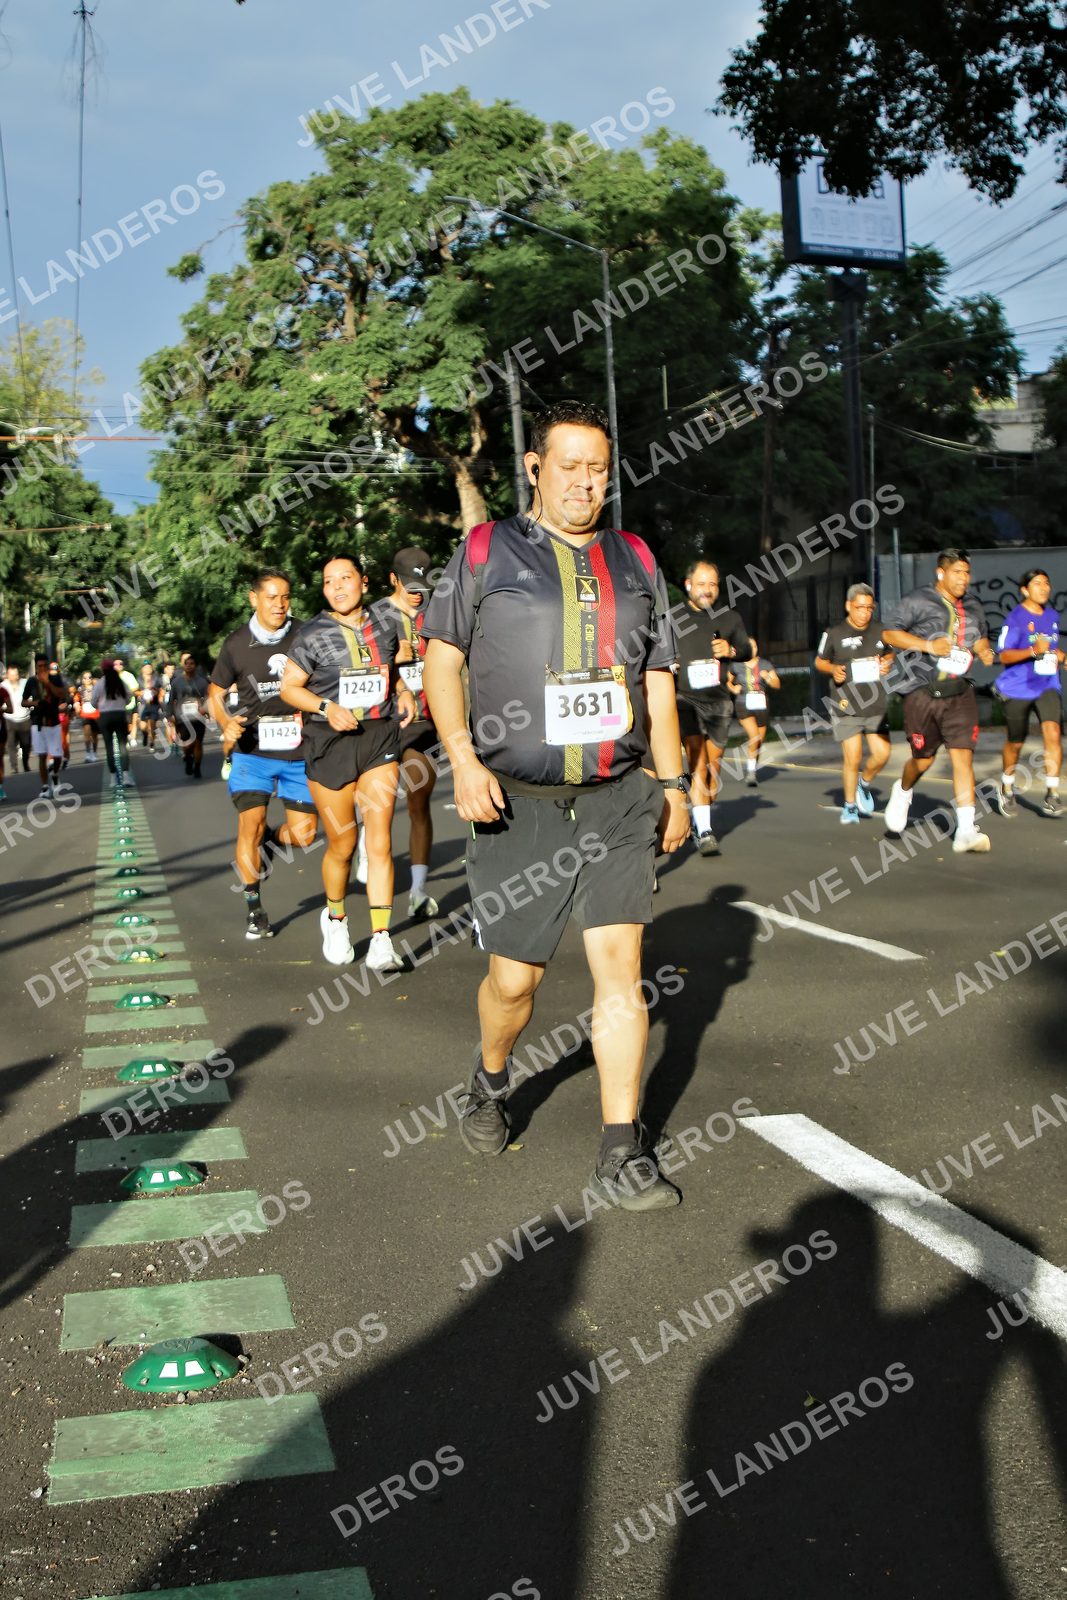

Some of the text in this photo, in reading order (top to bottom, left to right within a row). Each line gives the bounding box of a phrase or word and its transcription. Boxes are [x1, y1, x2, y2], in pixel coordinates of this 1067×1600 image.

[343, 679, 382, 695] 12421
[558, 691, 613, 718] 3631
[263, 727, 298, 739] 11424
